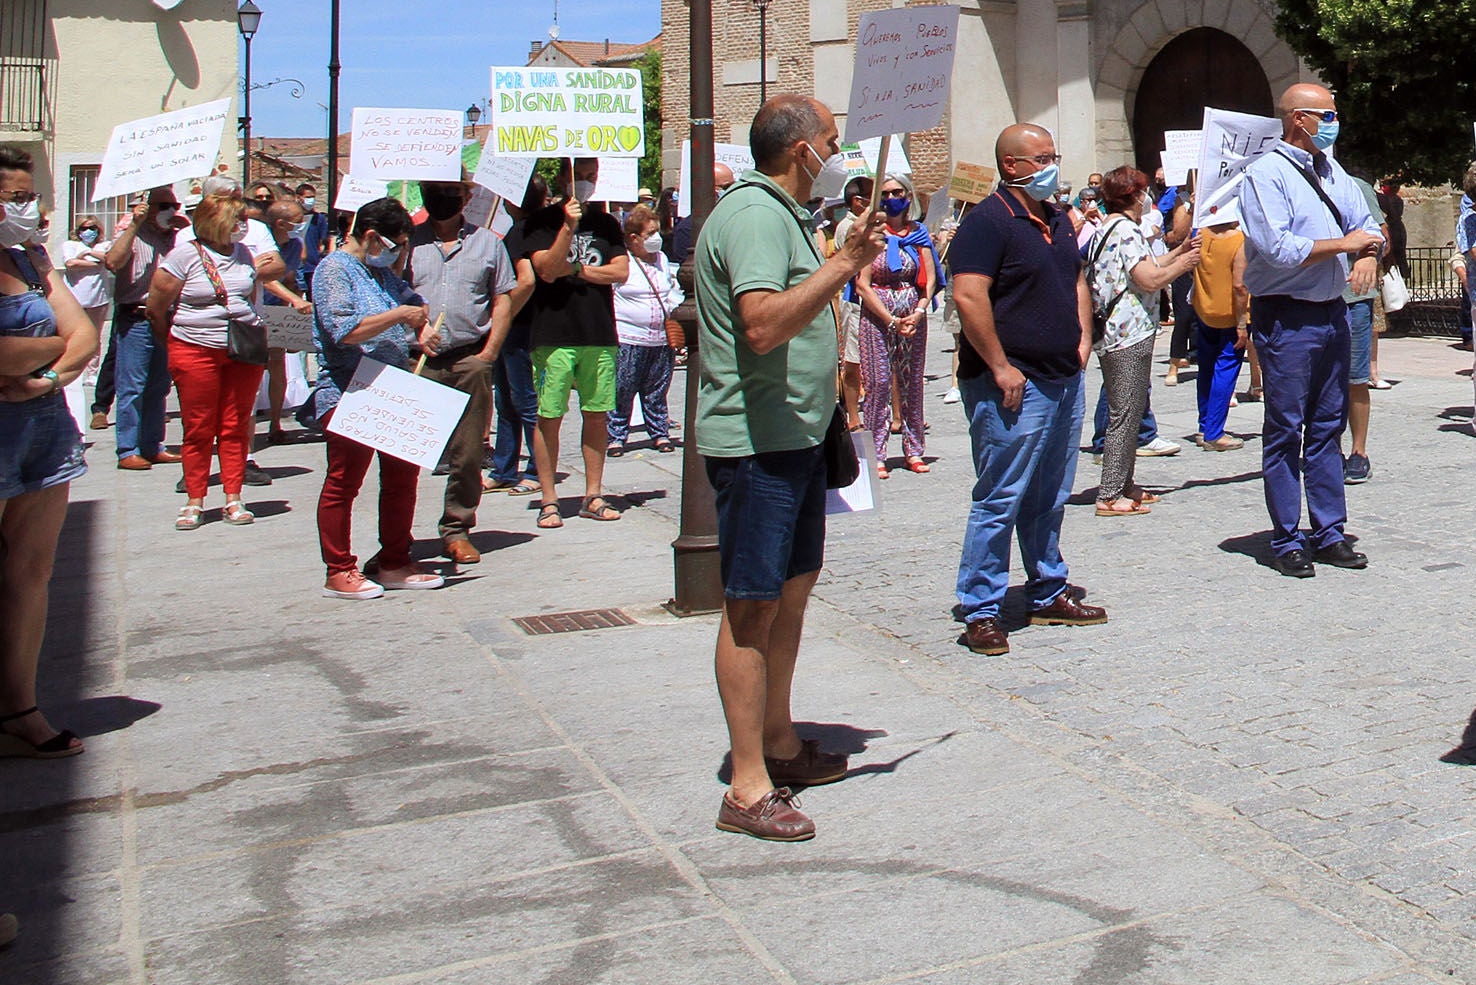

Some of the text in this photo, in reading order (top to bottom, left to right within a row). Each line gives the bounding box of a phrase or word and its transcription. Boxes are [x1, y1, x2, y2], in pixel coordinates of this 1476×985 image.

[495, 71, 524, 89] POR
[530, 71, 559, 88] UNA
[573, 92, 637, 114] RURAL
[364, 116, 460, 129] LOS CENTROS
[119, 131, 136, 144] LA
[358, 129, 379, 140] NO
[407, 128, 460, 139] VENDEN
[497, 125, 558, 152] NAVAS
[565, 129, 583, 148] DE
[122, 134, 208, 160] SIN SANIDAD
[367, 142, 392, 151] SE
[339, 417, 428, 458] LOS CENTROS
